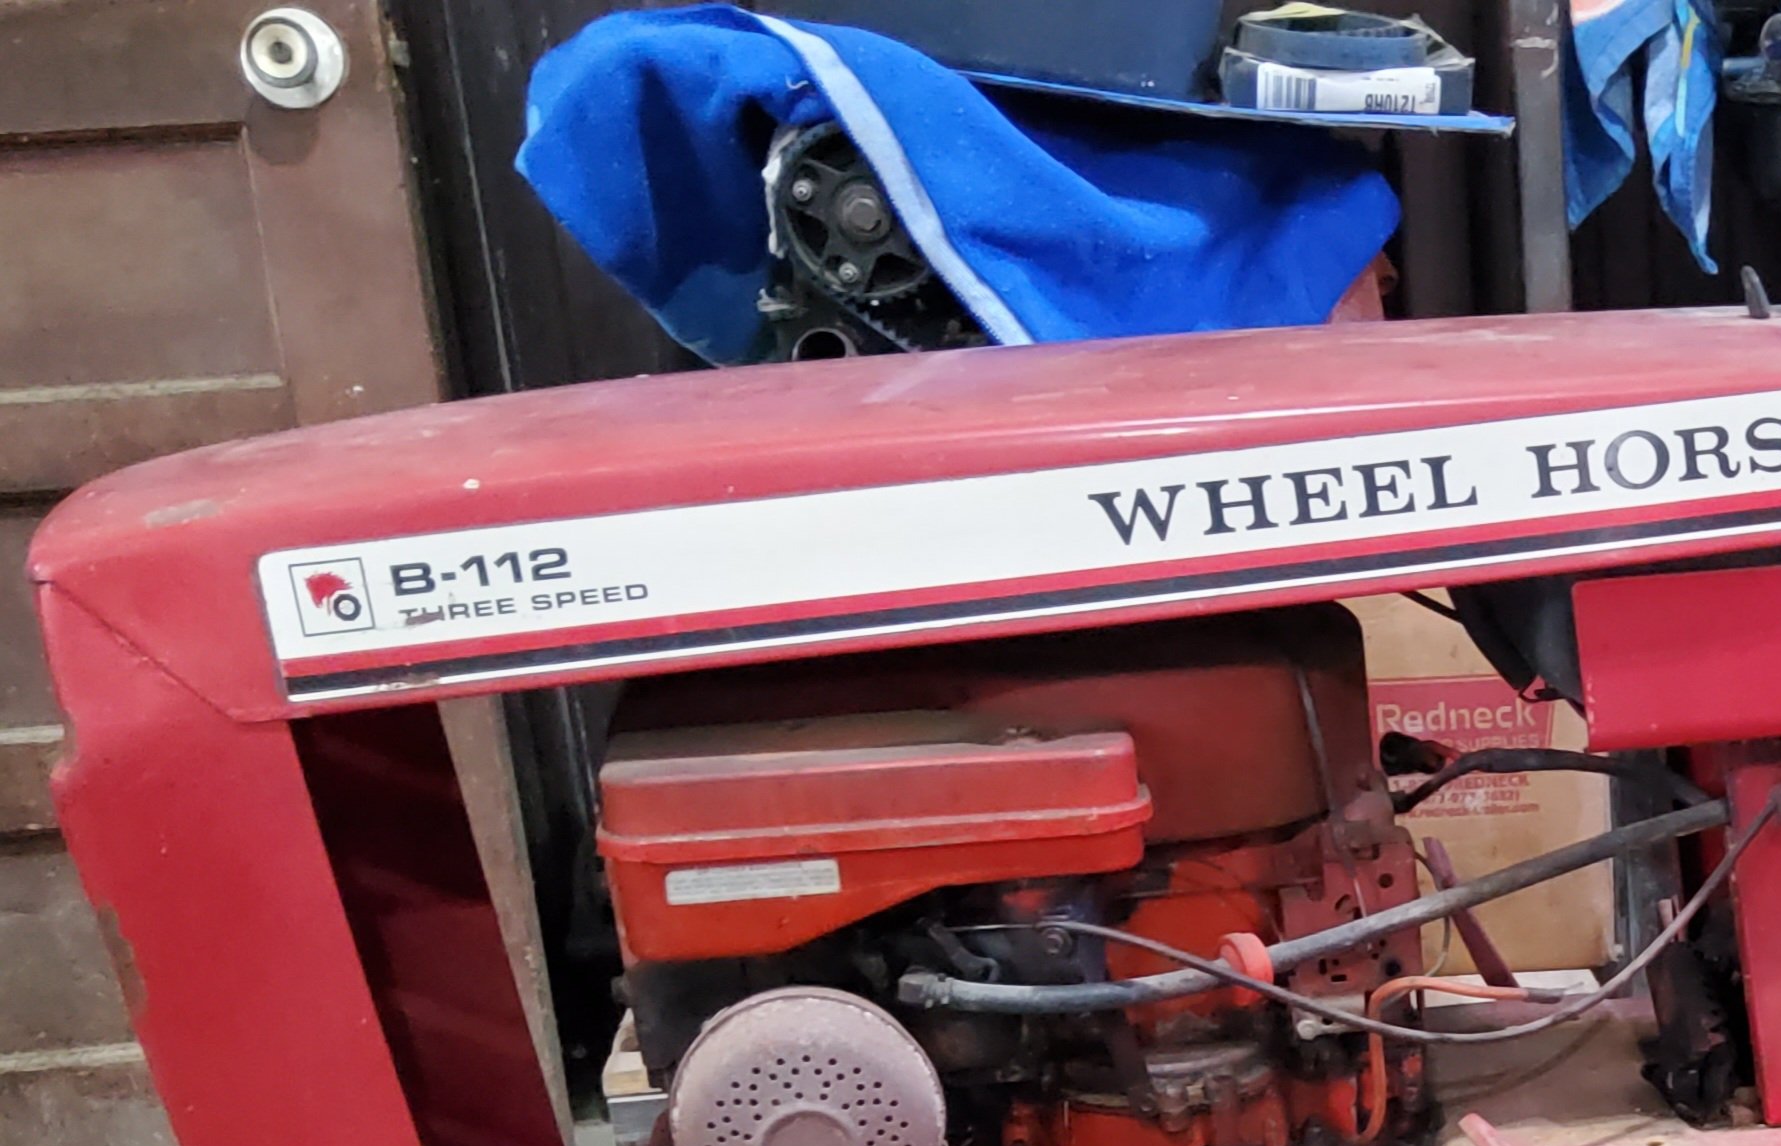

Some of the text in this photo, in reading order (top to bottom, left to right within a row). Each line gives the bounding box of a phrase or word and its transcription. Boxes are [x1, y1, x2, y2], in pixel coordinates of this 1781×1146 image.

[1088, 454, 1478, 546] WHEEL
[390, 547, 572, 597] B-112
[398, 583, 649, 625] THREE SPEED
[1376, 701, 1536, 733] Redneck
